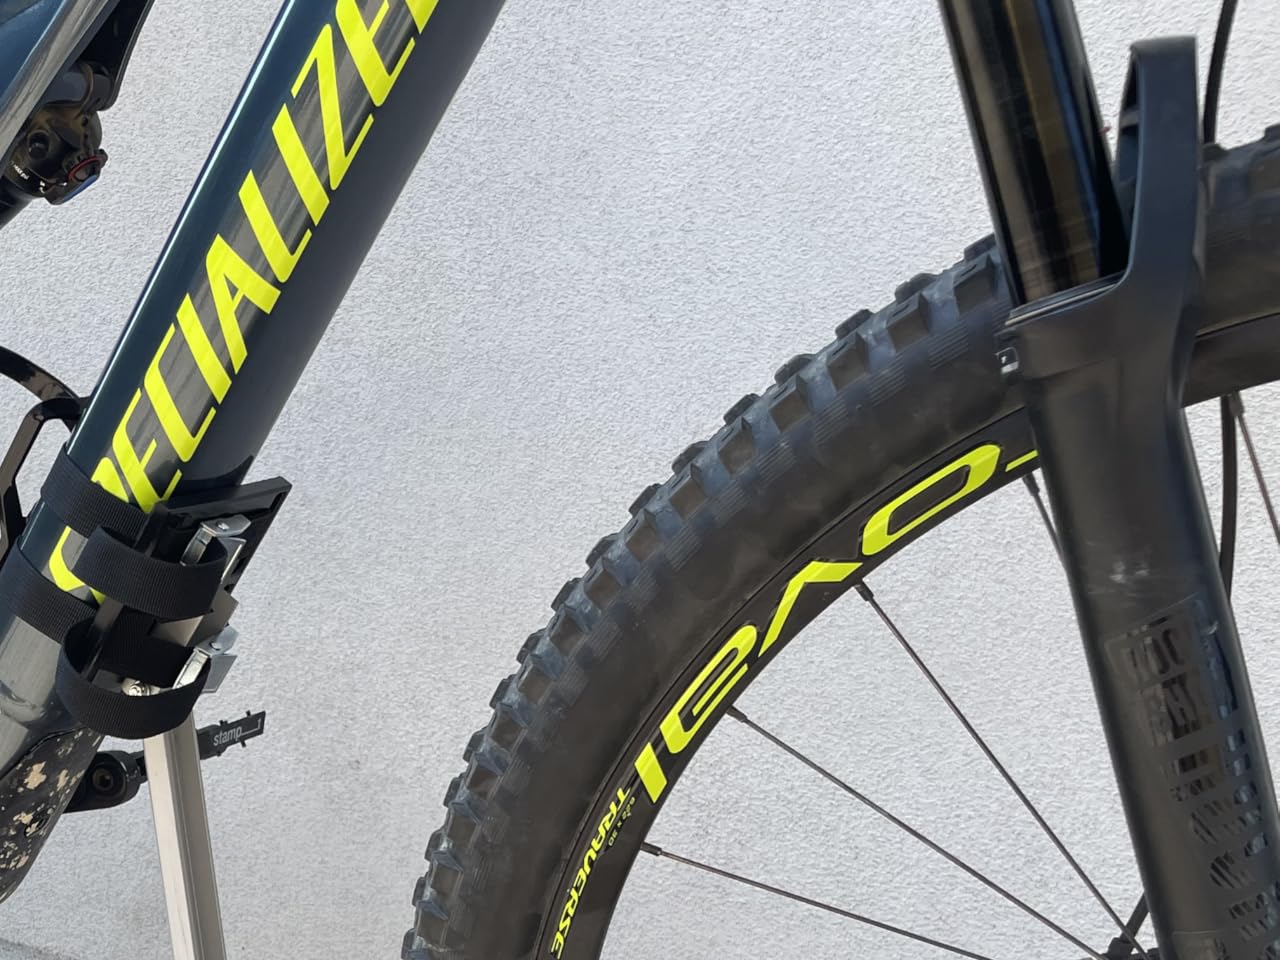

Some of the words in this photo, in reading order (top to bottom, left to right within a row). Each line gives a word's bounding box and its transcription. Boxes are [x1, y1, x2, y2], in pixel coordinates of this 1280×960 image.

[49, 0, 439, 603] ECIALIZE
[213, 726, 242, 746] stamp
[551, 787, 631, 960] TRAVERSE
